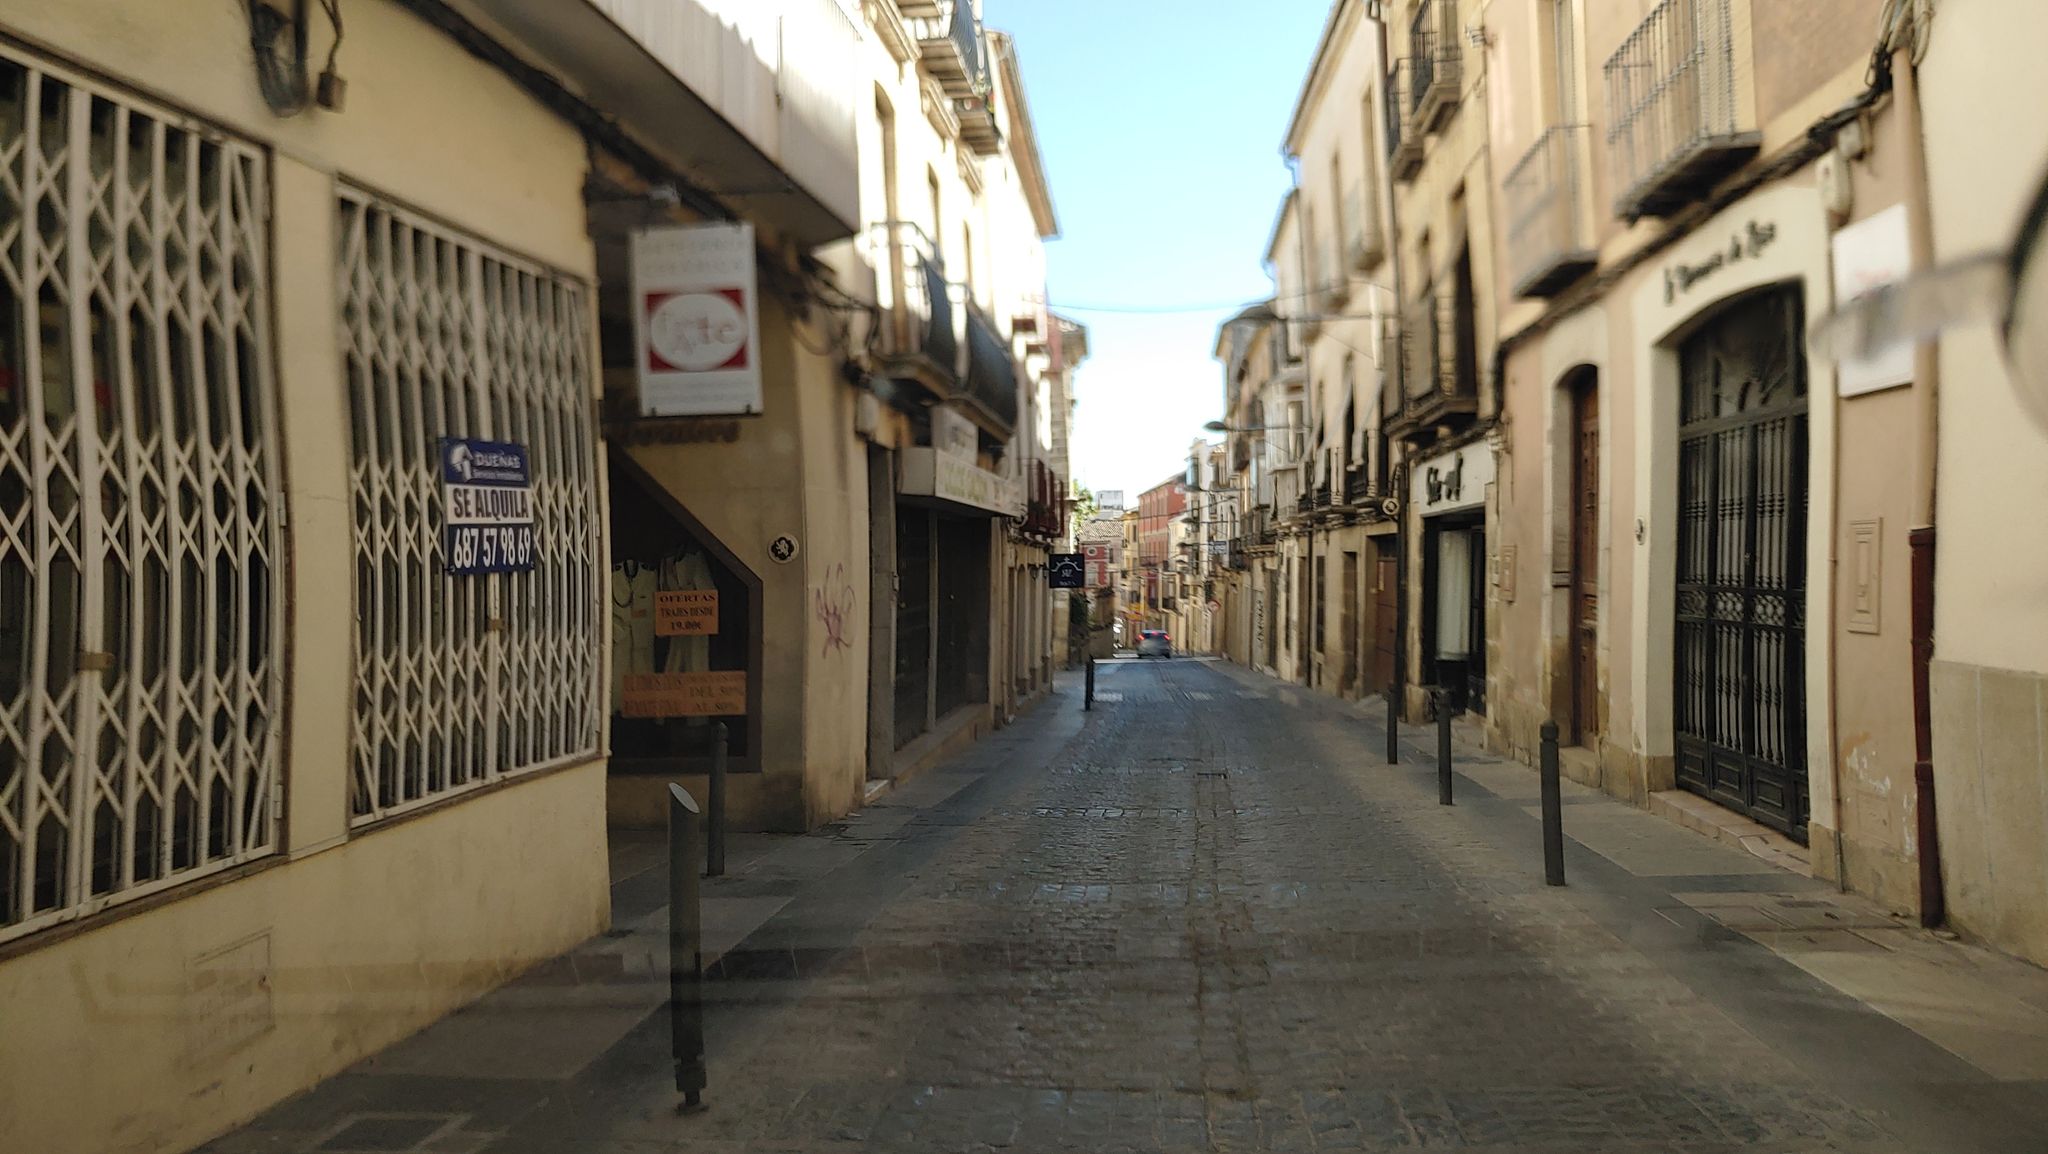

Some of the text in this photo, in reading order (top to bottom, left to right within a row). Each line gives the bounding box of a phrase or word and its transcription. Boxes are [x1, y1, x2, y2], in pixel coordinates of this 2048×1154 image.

[453, 488, 529, 520] SE ALQUILA
[454, 527, 531, 569] 687 57 98 69
[659, 594, 716, 603] OFERTAS
